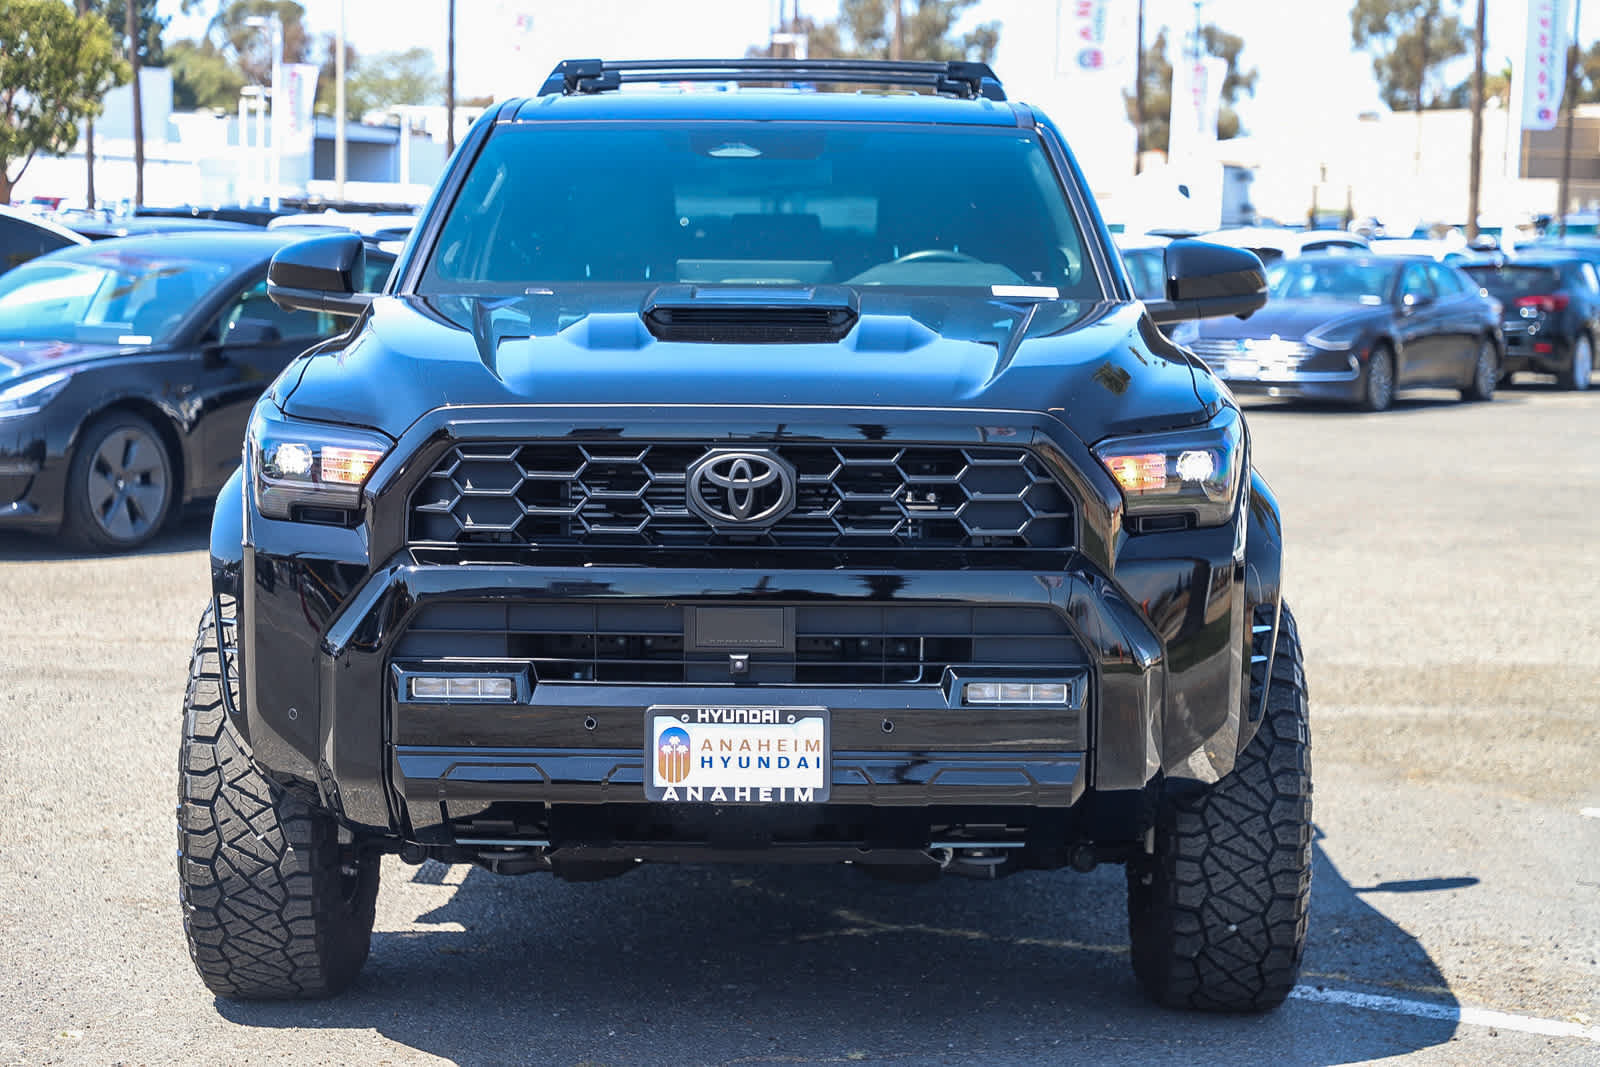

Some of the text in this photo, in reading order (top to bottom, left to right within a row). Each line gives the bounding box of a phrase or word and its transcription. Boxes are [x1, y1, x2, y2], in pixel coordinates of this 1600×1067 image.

[697, 709, 780, 723] HYUNDAI
[701, 739, 820, 752] ANAHEIM
[701, 756, 820, 769] HYUNDAI
[662, 786, 814, 802] ANAHEIM
